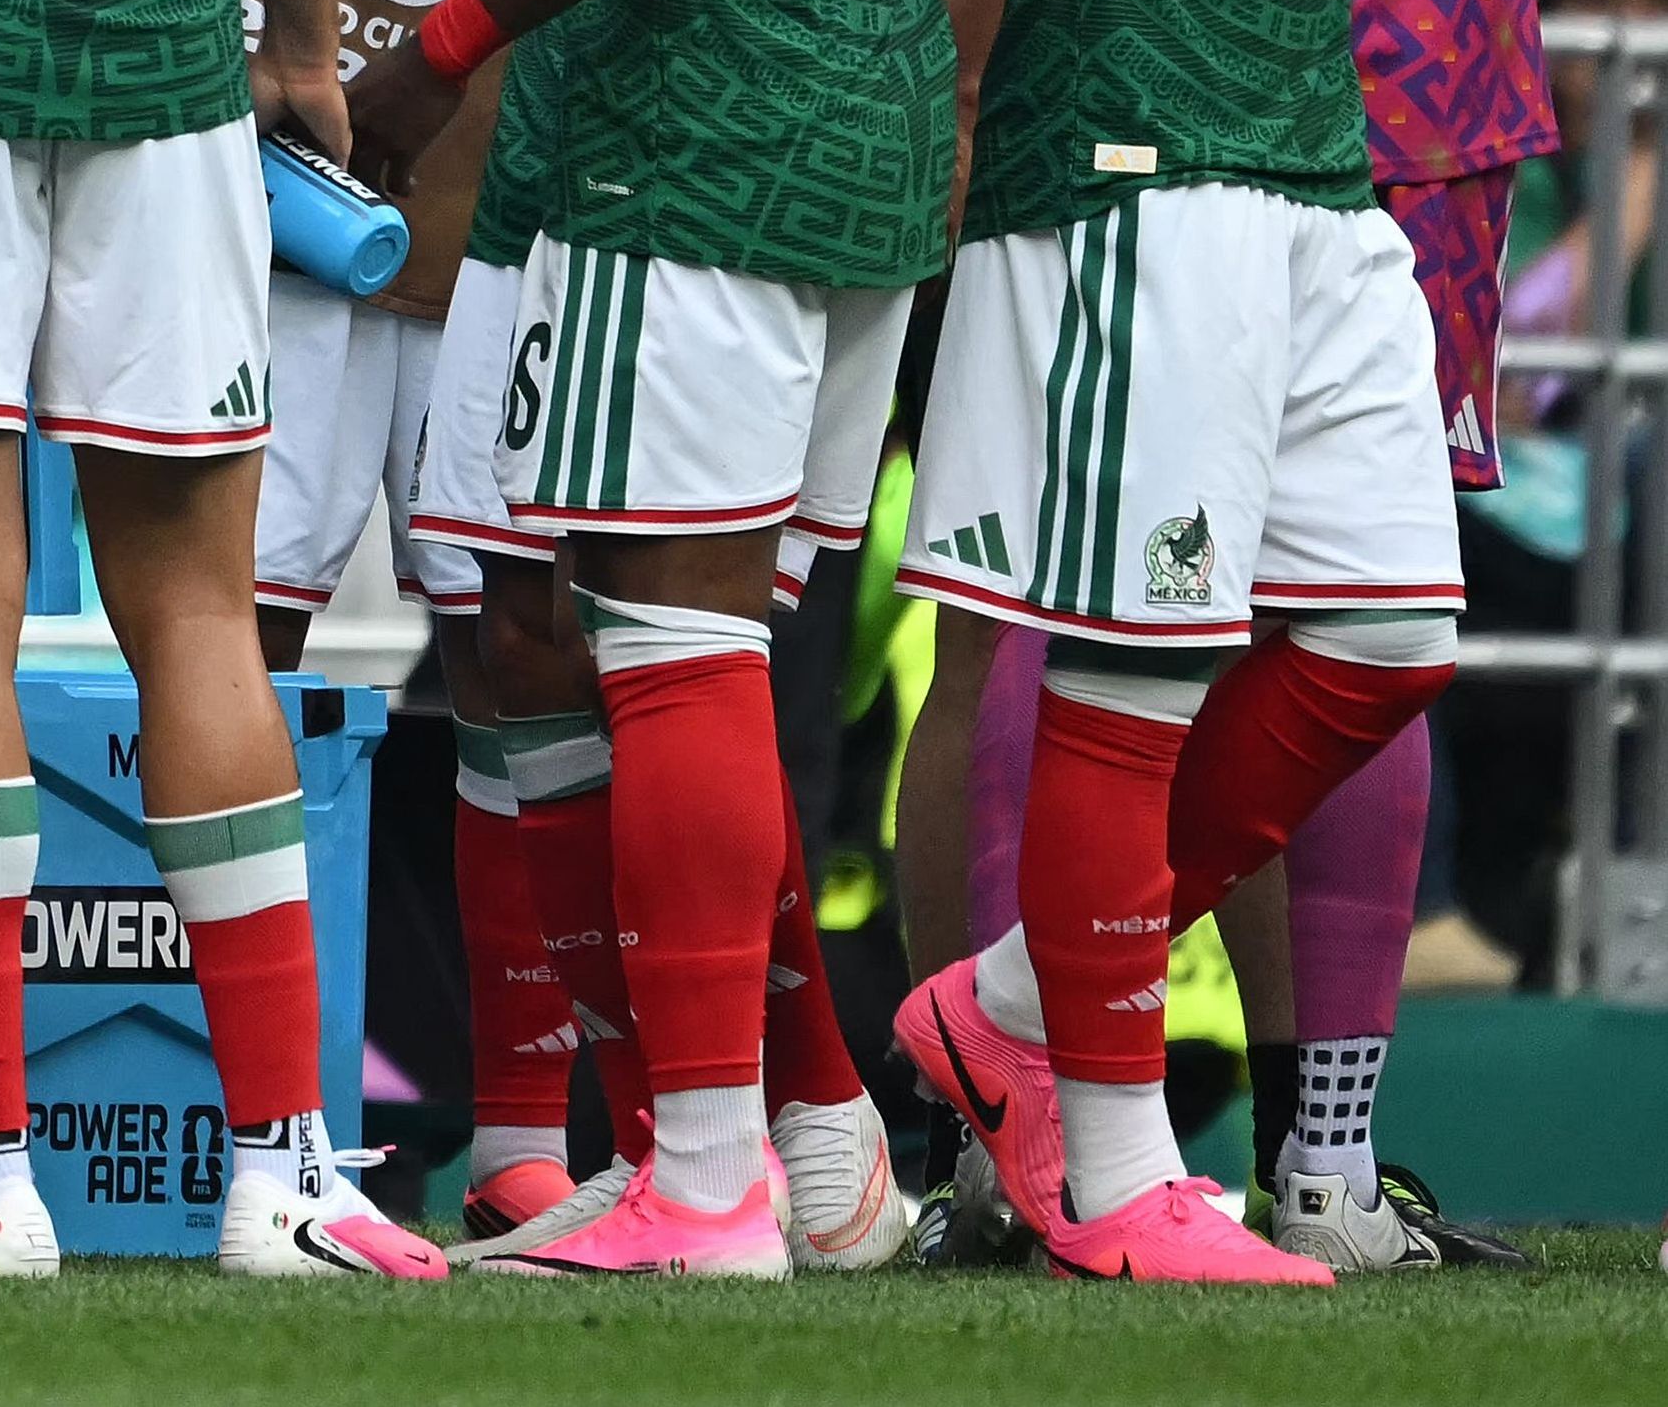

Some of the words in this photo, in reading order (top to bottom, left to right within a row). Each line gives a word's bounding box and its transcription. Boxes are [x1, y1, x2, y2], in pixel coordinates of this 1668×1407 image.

[1149, 586, 1208, 601] MÉXICO
[21, 900, 191, 969] OWER
[1092, 915, 1171, 935] MÉXI
[26, 1102, 169, 1152] POWER
[87, 1154, 169, 1205] ADE
